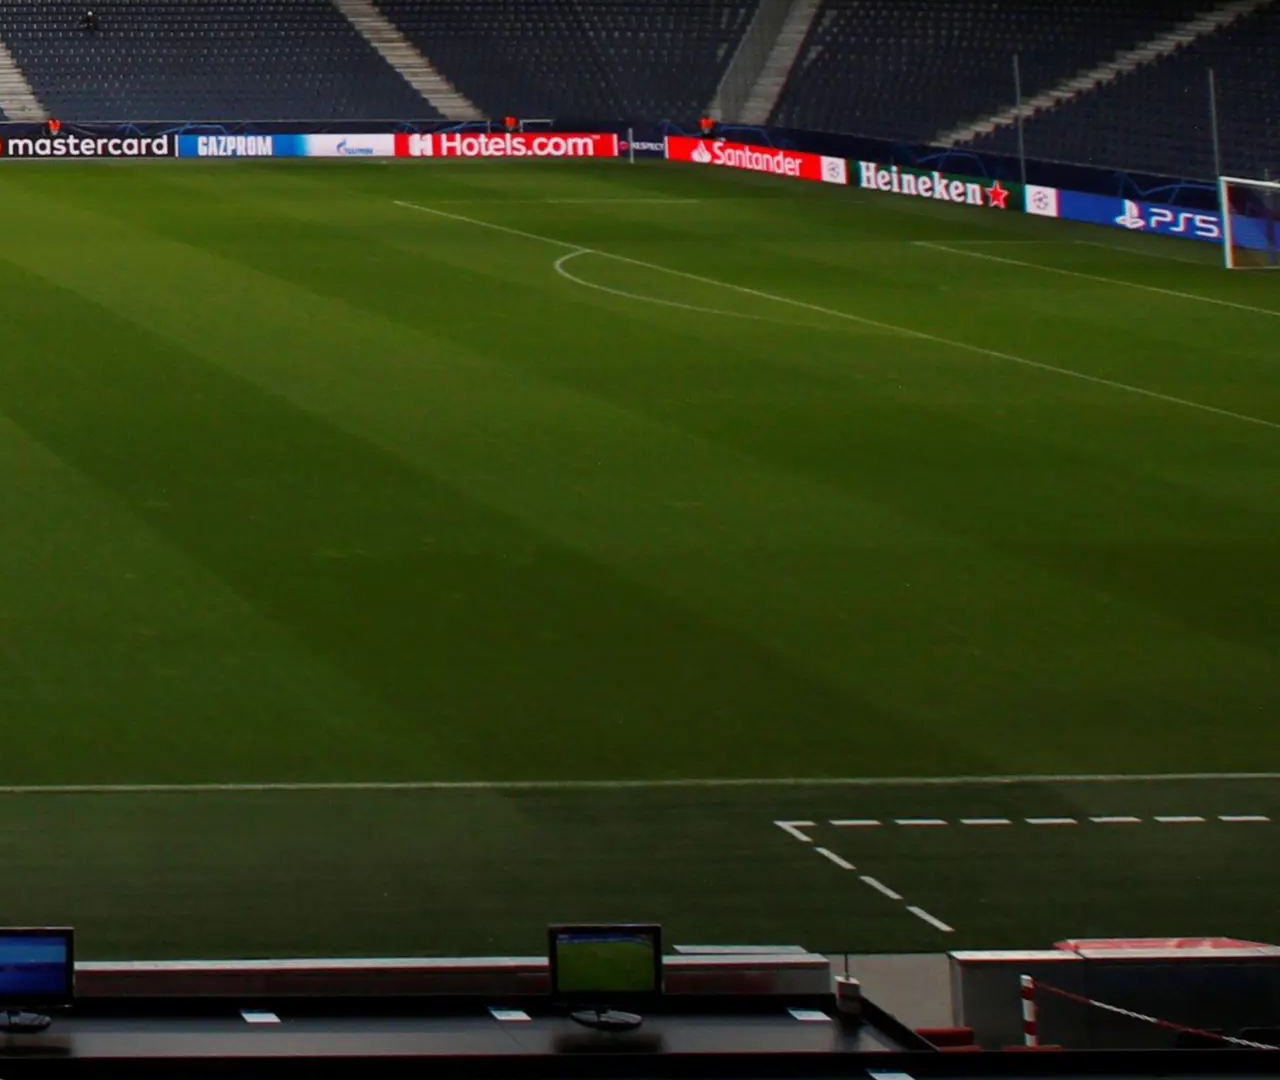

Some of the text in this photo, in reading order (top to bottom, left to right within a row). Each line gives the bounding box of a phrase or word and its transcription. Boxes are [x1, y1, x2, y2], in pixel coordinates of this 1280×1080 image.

[8, 134, 168, 156] mastercard
[197, 135, 272, 156] GAZPROM
[441, 132, 594, 156] Hotels.com
[630, 142, 663, 151] RESPECT
[713, 141, 802, 177] Santander
[860, 160, 983, 206] Heineken
[1150, 208, 1219, 237] PS5
